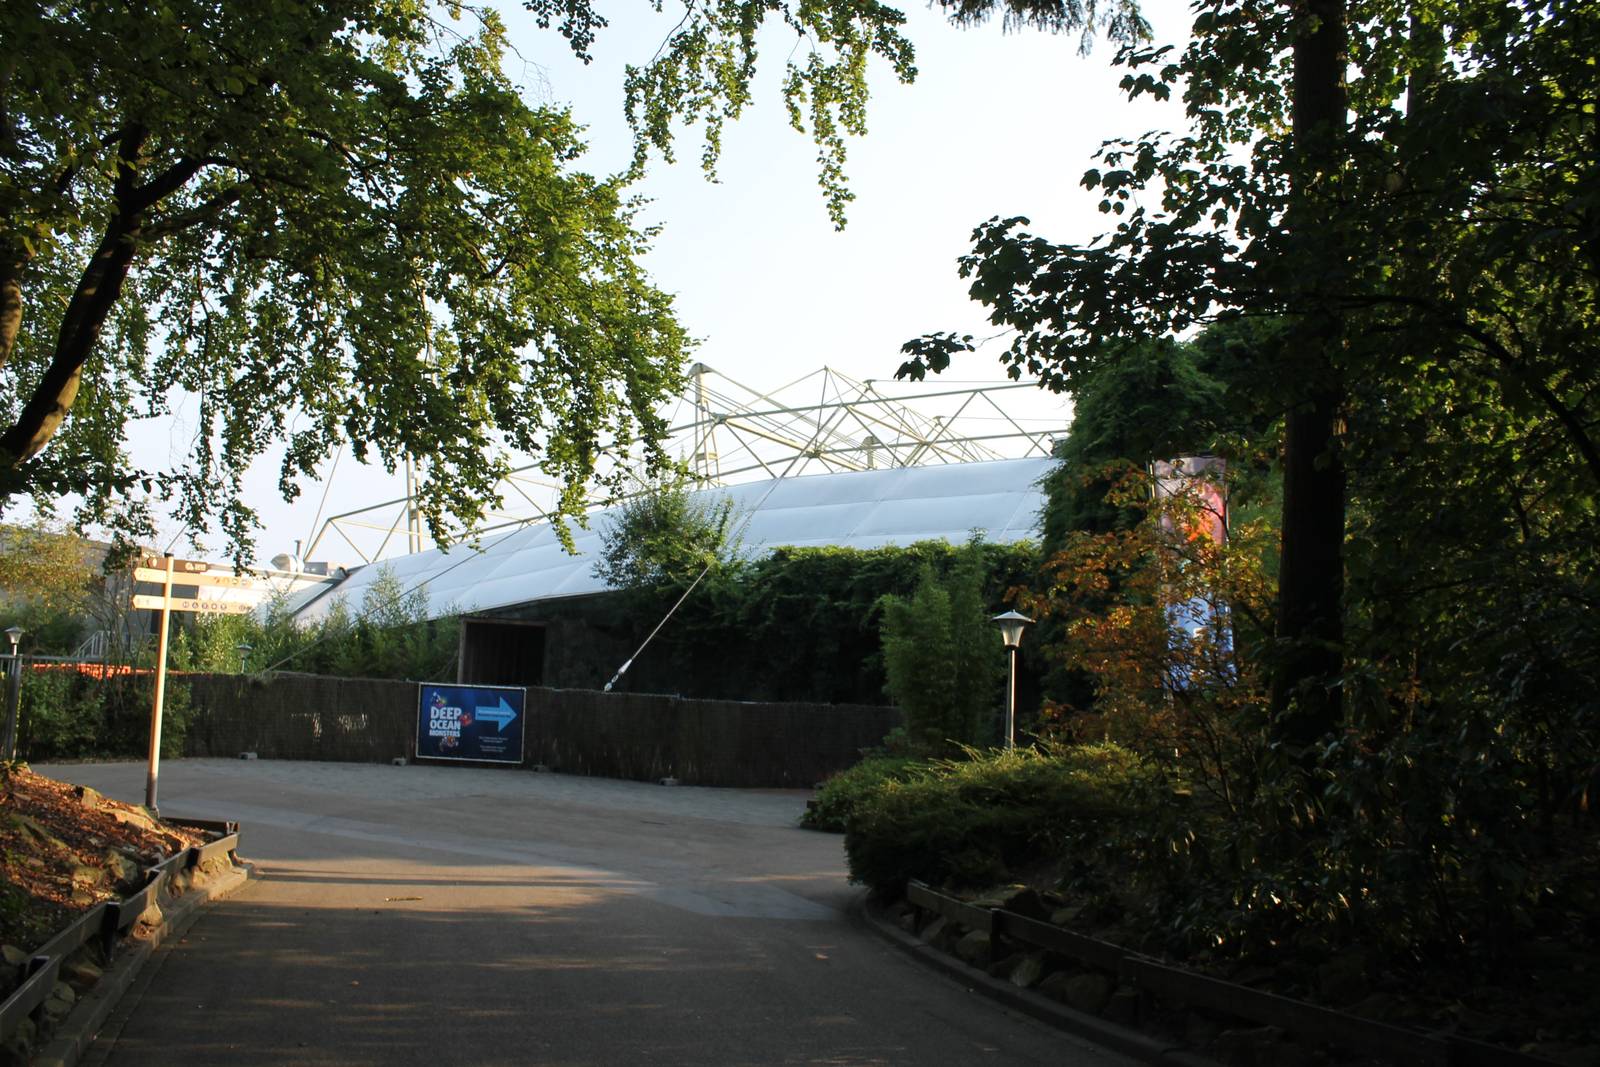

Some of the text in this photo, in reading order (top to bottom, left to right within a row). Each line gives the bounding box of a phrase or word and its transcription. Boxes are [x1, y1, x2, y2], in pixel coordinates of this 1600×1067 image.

[430, 706, 462, 720] DEEP
[429, 719, 461, 730] OCEAN
[429, 729, 461, 738] MONSTERS
